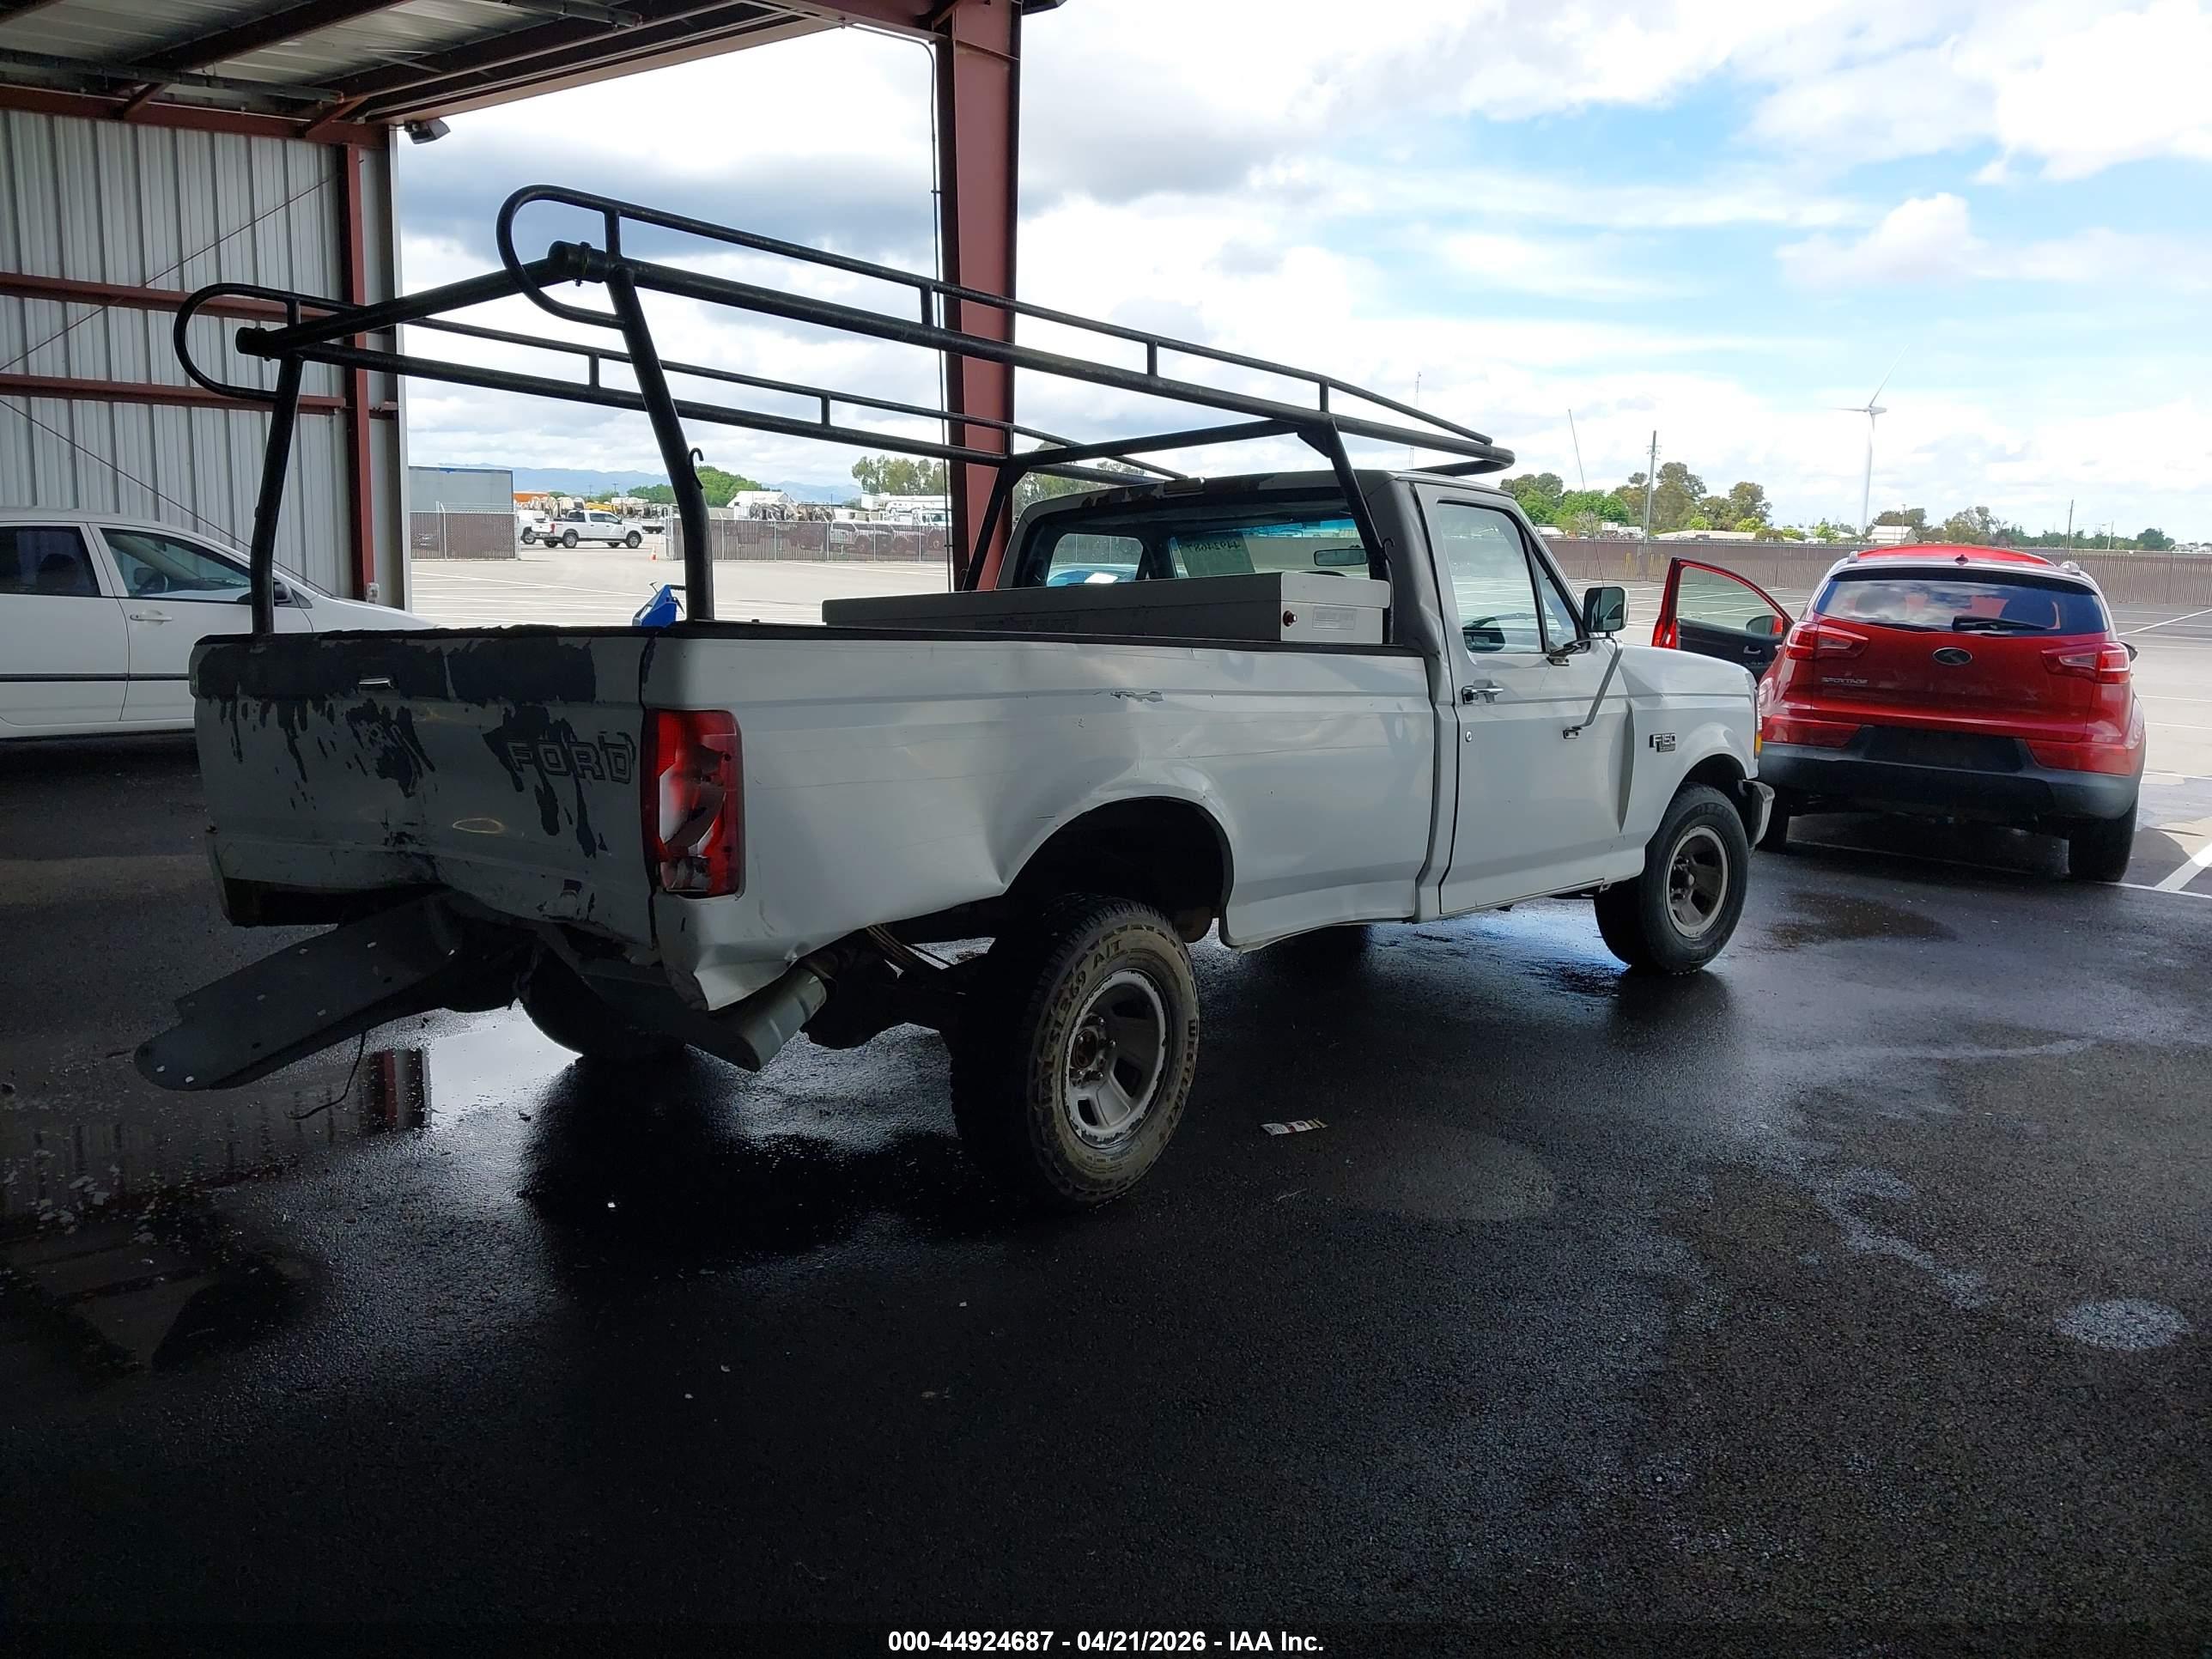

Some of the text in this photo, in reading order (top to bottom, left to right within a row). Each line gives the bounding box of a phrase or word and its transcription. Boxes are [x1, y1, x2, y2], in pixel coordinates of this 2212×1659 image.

[506, 739, 632, 785] FORD
[1049, 969, 1087, 1042] SL369
[1092, 939, 1122, 969] A/T
